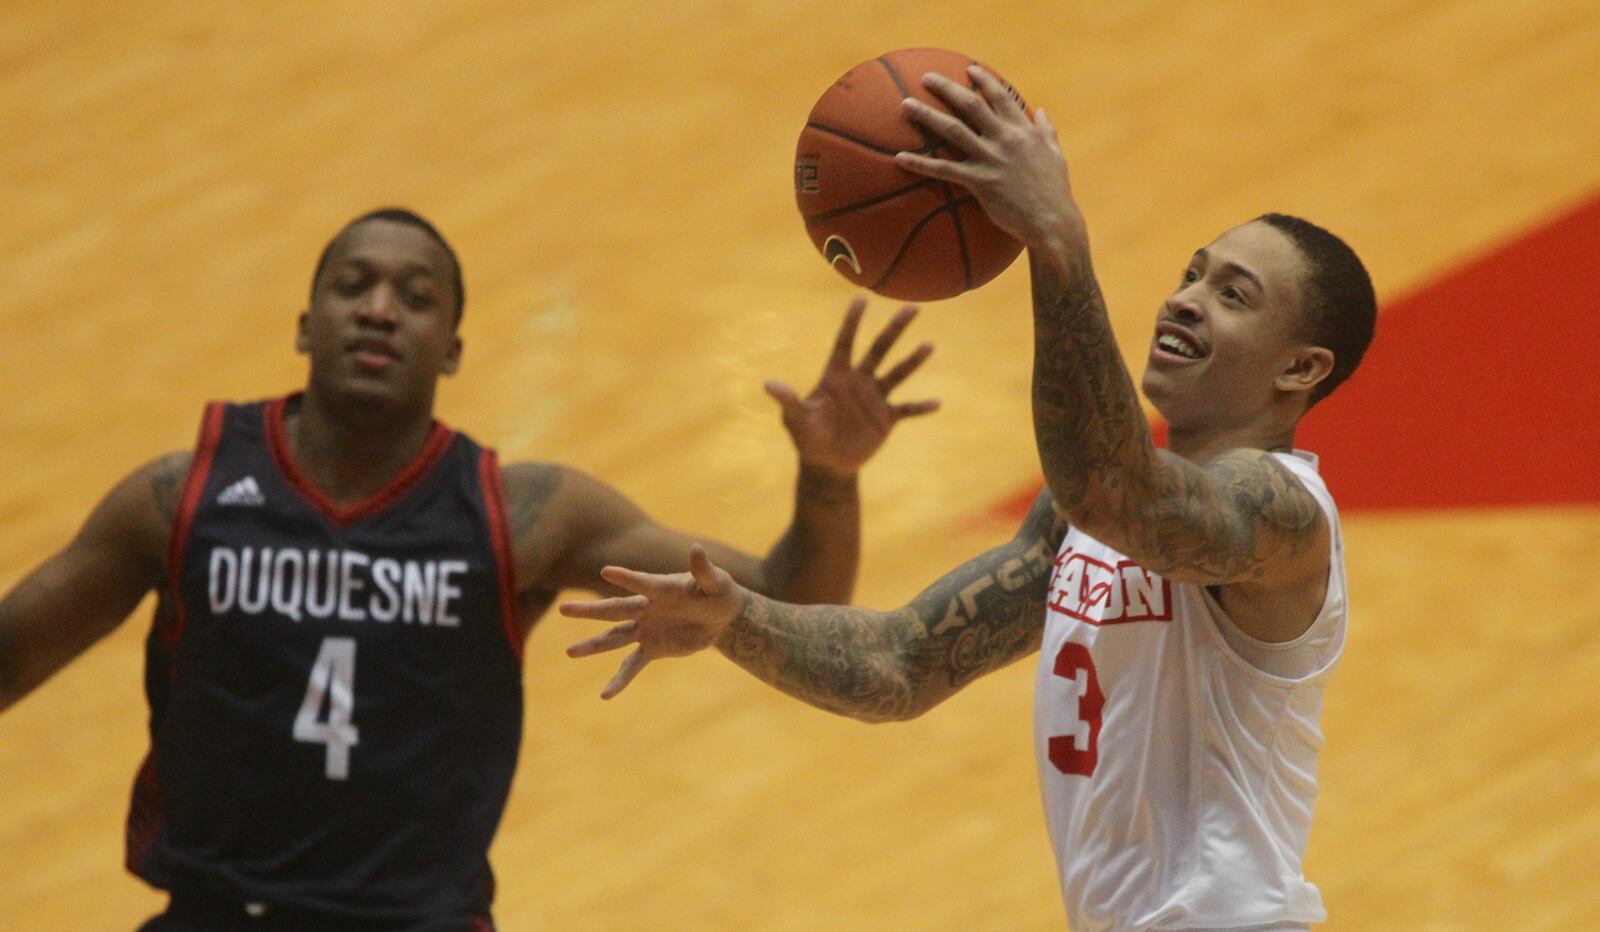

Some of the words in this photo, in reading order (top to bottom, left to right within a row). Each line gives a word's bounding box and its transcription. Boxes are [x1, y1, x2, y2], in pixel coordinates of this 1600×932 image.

[208, 546, 468, 627] DUQUESNE
[293, 638, 361, 781] 4
[1048, 641, 1106, 778] 3
